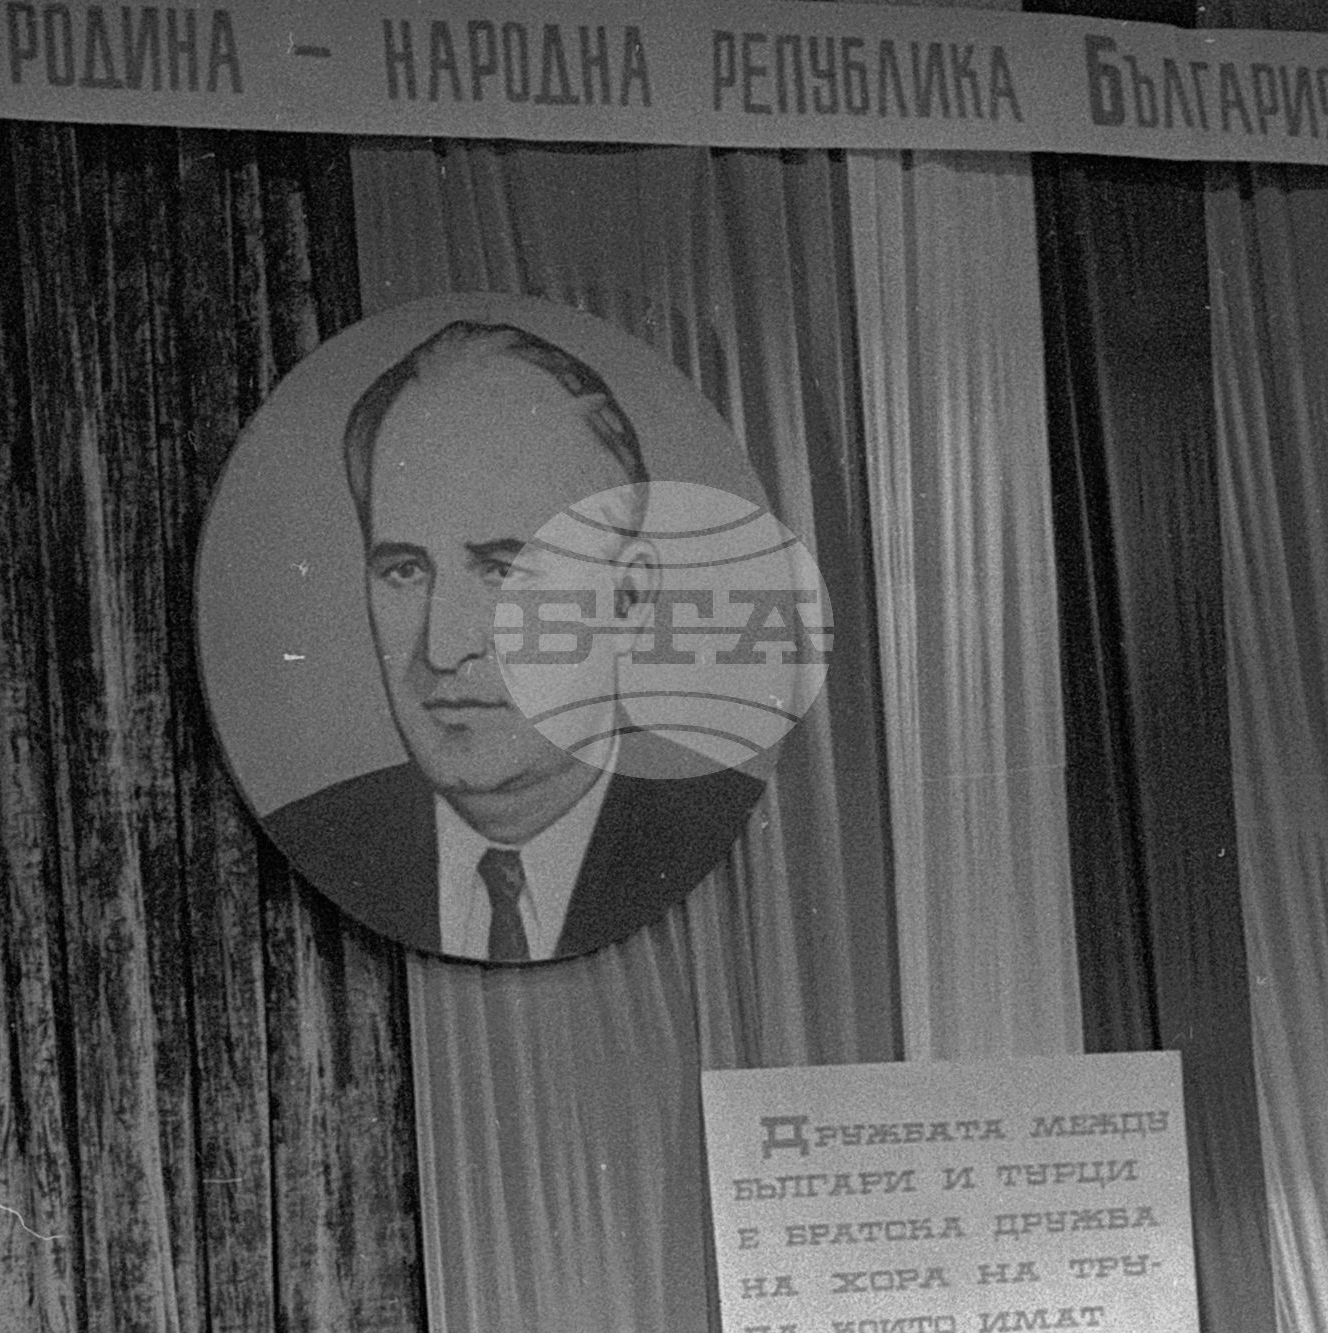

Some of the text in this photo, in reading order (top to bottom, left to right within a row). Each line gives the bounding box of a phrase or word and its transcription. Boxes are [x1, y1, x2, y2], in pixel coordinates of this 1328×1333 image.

[6, 2, 244, 94] РОДИНА
[382, 18, 652, 107] НАРОДНА
[712, 28, 1024, 123] РЕПУБЛИКА
[760, 1110, 1170, 1159] ДРУЖБАТА МЕЖДУ
[733, 1159, 1139, 1202] БЪЛГАРИ И ТУРЦИ
[738, 1207, 1160, 1250] Е БРАТСКА ДРУЖБА
[741, 1275, 799, 1300] НА
[832, 1269, 950, 1294] ХОРА
[977, 1263, 1040, 1285] НА
